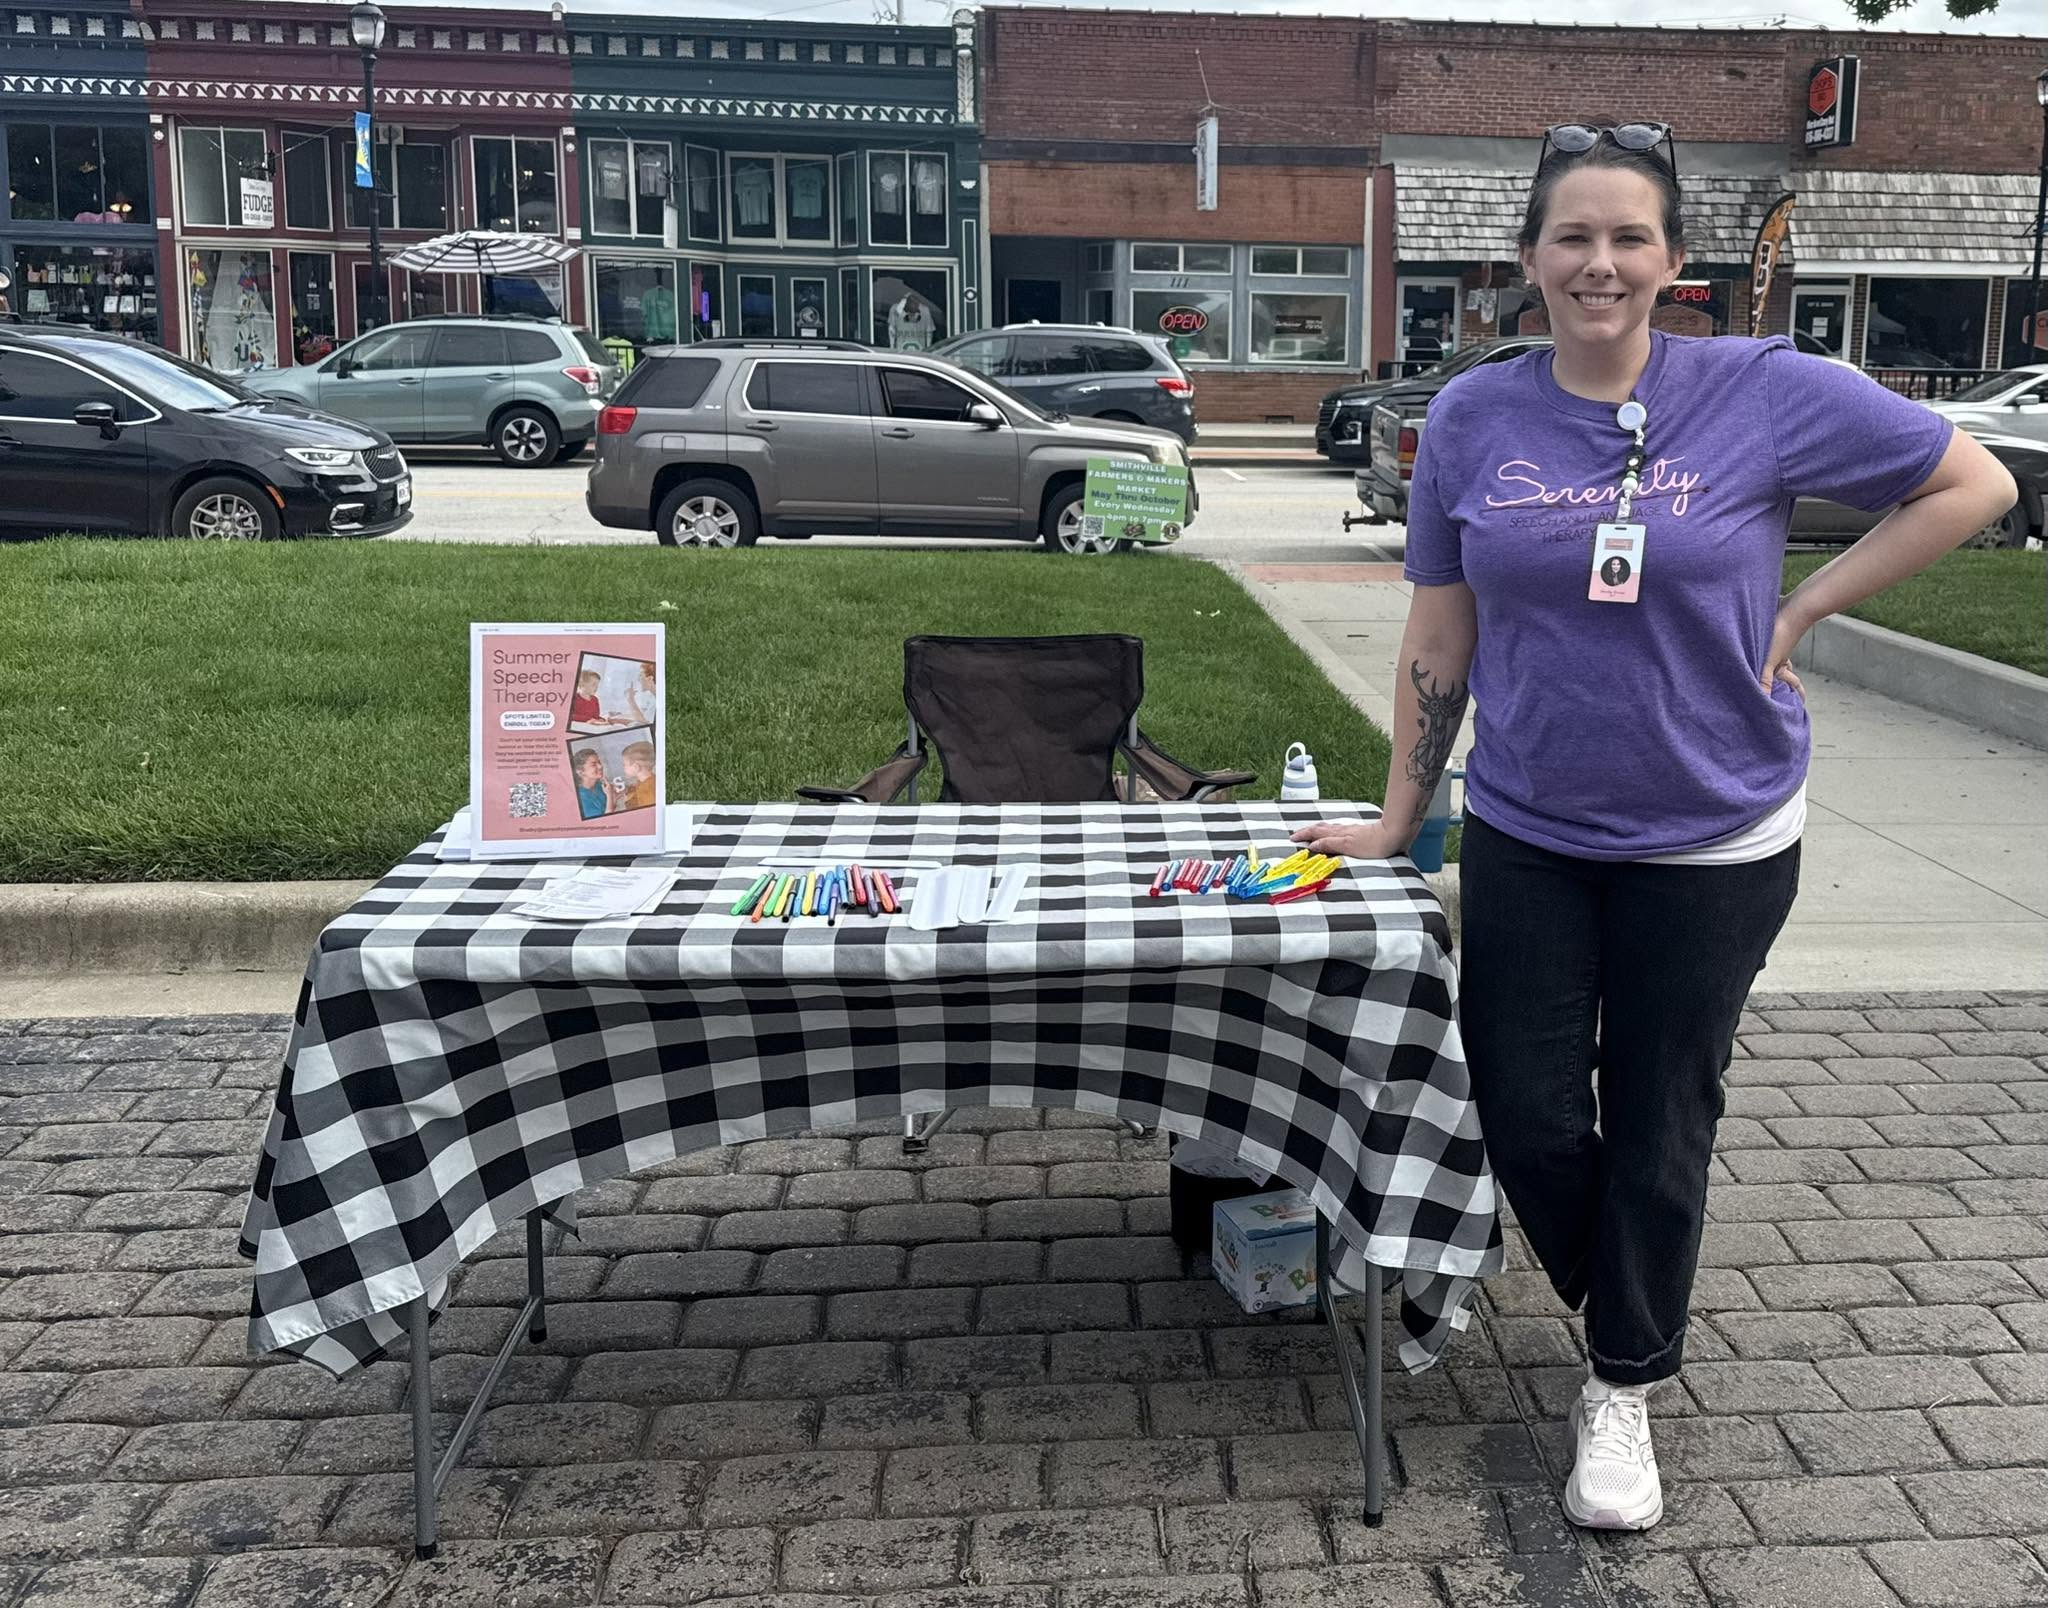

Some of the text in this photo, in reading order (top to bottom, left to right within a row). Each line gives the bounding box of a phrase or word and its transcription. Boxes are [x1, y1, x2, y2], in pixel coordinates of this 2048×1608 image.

[243, 193, 273, 213] FUDGE
[1170, 277, 1190, 289] 111
[1674, 287, 1711, 302] OPEN
[1162, 313, 1203, 330] OPEN
[1109, 460, 1167, 473] SMITHVILLE
[1088, 469, 1134, 482] FARMERS
[1146, 475, 1187, 487] MAKERS
[1485, 455, 1701, 517] Serenity
[1091, 489, 1181, 506] May Thru October
[1116, 484, 1157, 495] MARKET
[1094, 500, 1176, 515] Every Wednesday
[1588, 505, 1662, 523] LANAGE
[1142, 515, 1162, 525] 7pm
[493, 649, 572, 665] Summer
[493, 668, 563, 688] Speech
[493, 688, 569, 708] Therapy
